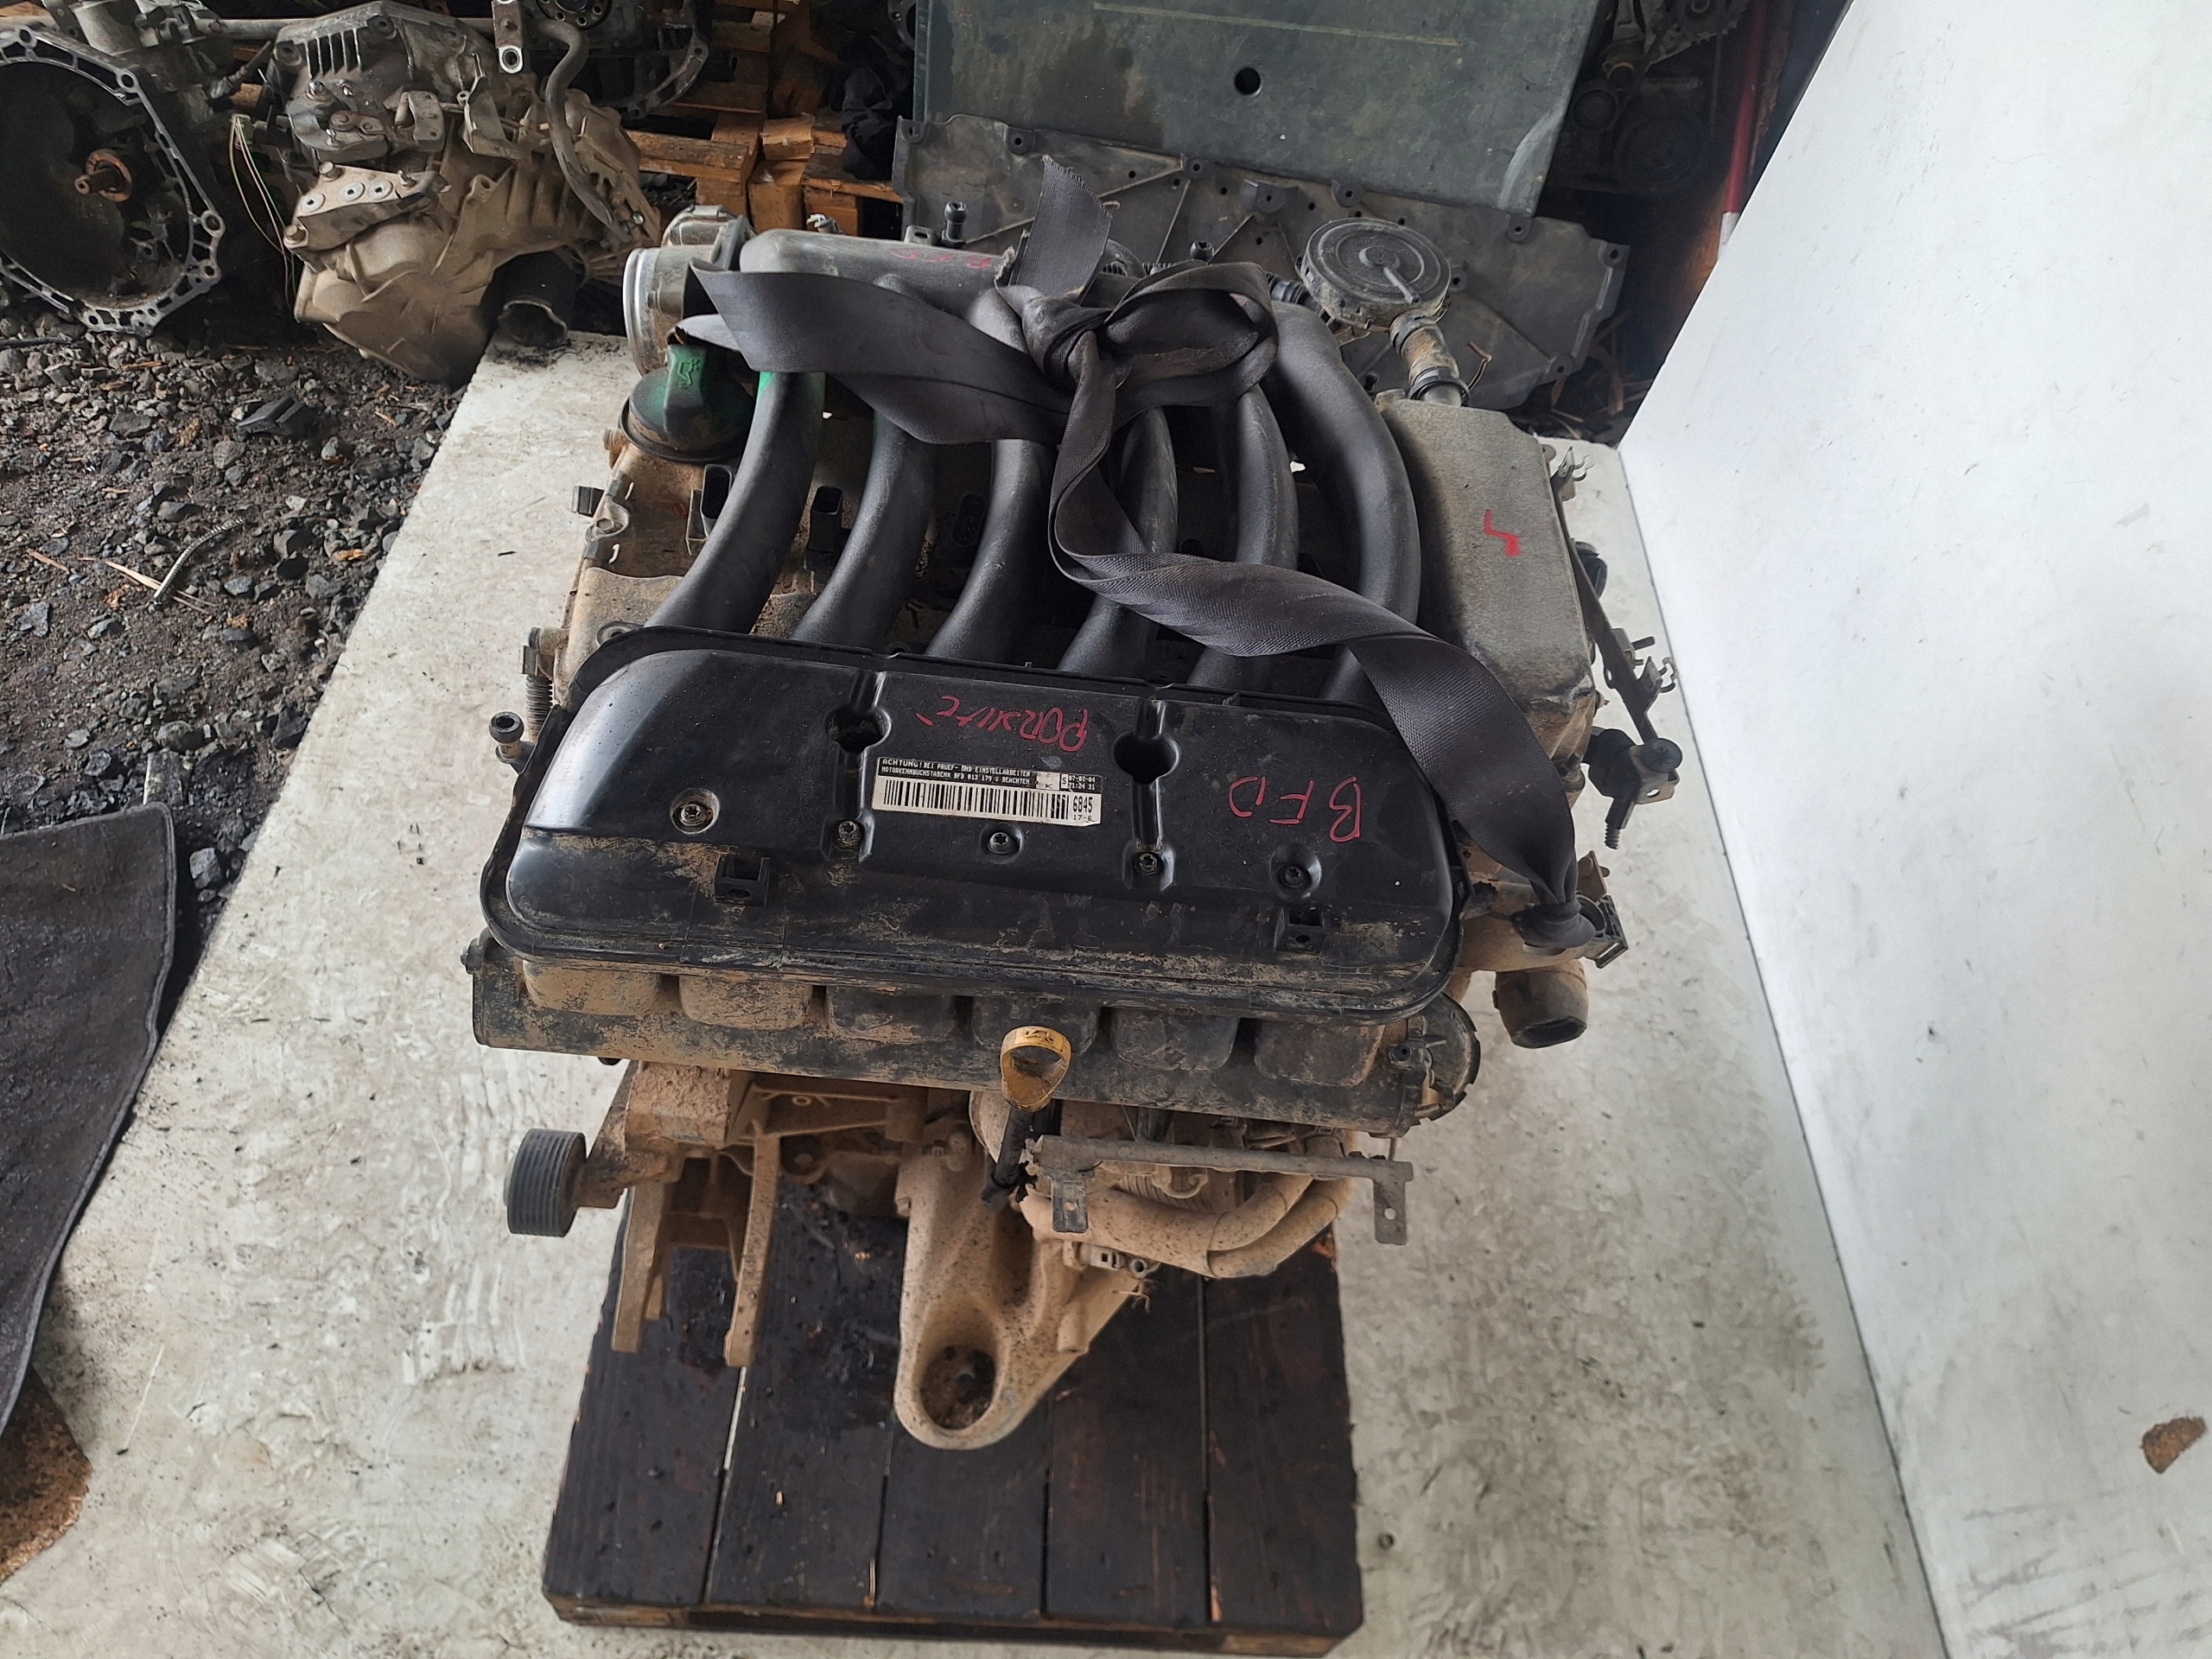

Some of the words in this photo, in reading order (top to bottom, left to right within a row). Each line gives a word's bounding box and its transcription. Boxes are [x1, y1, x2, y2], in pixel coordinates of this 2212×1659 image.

[882, 758, 922, 768] ACHTUNG!
[975, 765, 1030, 777] EINSTELLARBEITEN
[1001, 776, 1030, 785] BEACHTEN
[1072, 795, 1093, 813] 6845
[1228, 776, 1361, 842] BFD
